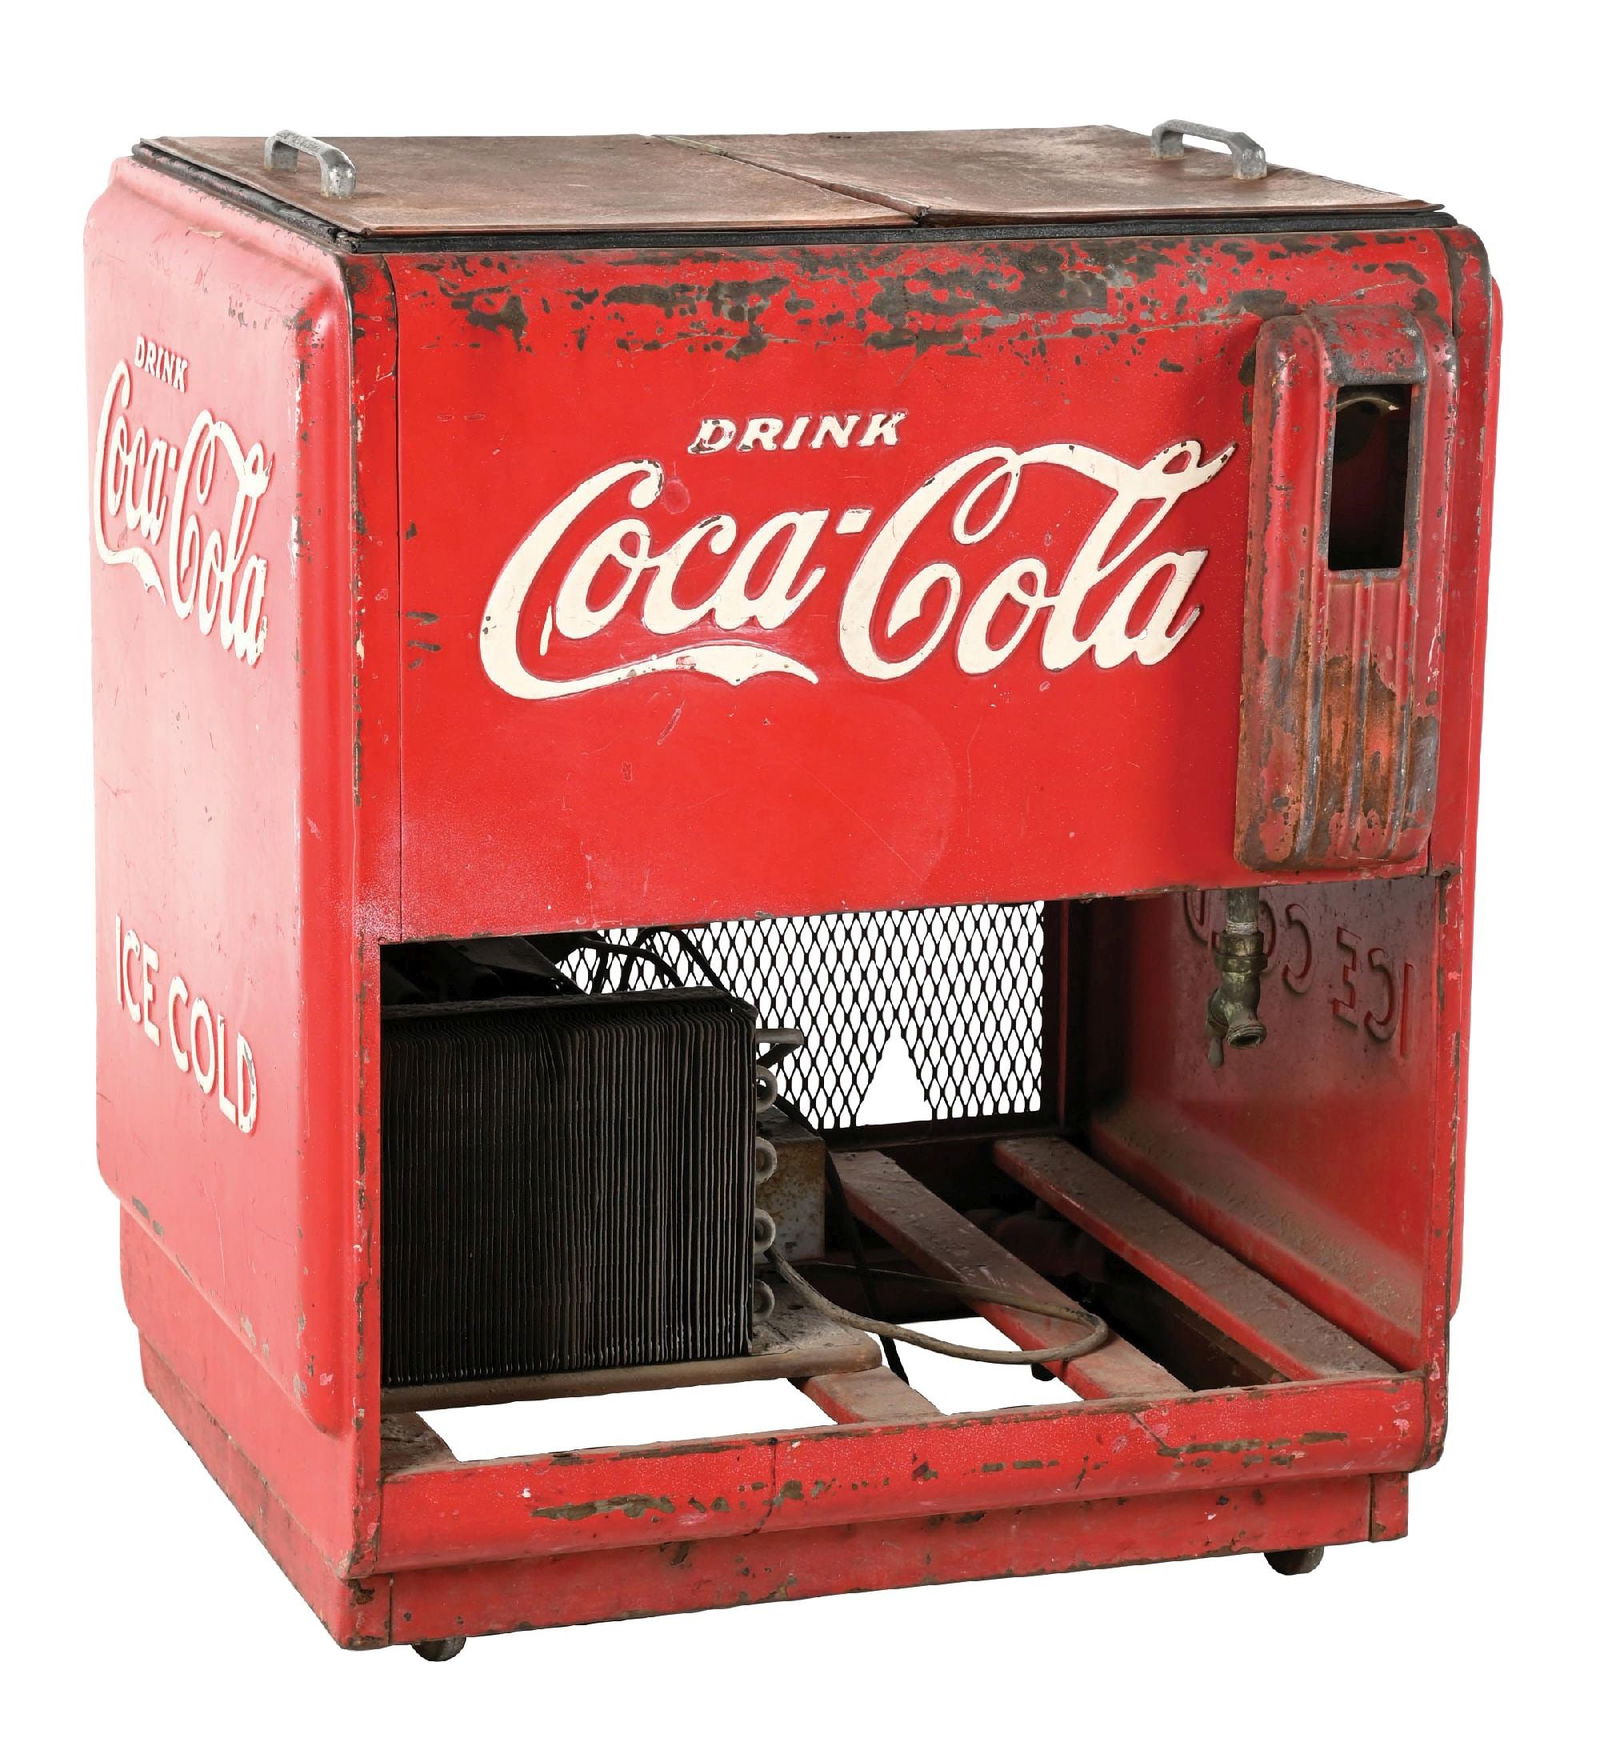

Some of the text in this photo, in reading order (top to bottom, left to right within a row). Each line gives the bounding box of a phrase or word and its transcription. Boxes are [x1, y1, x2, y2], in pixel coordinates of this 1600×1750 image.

[135, 335, 188, 392] DRINK
[688, 411, 908, 454] DRINK
[94, 359, 273, 664] Coca-Cola
[479, 439, 1237, 699] Coca-Cola
[116, 912, 257, 1134] ICE COLD
